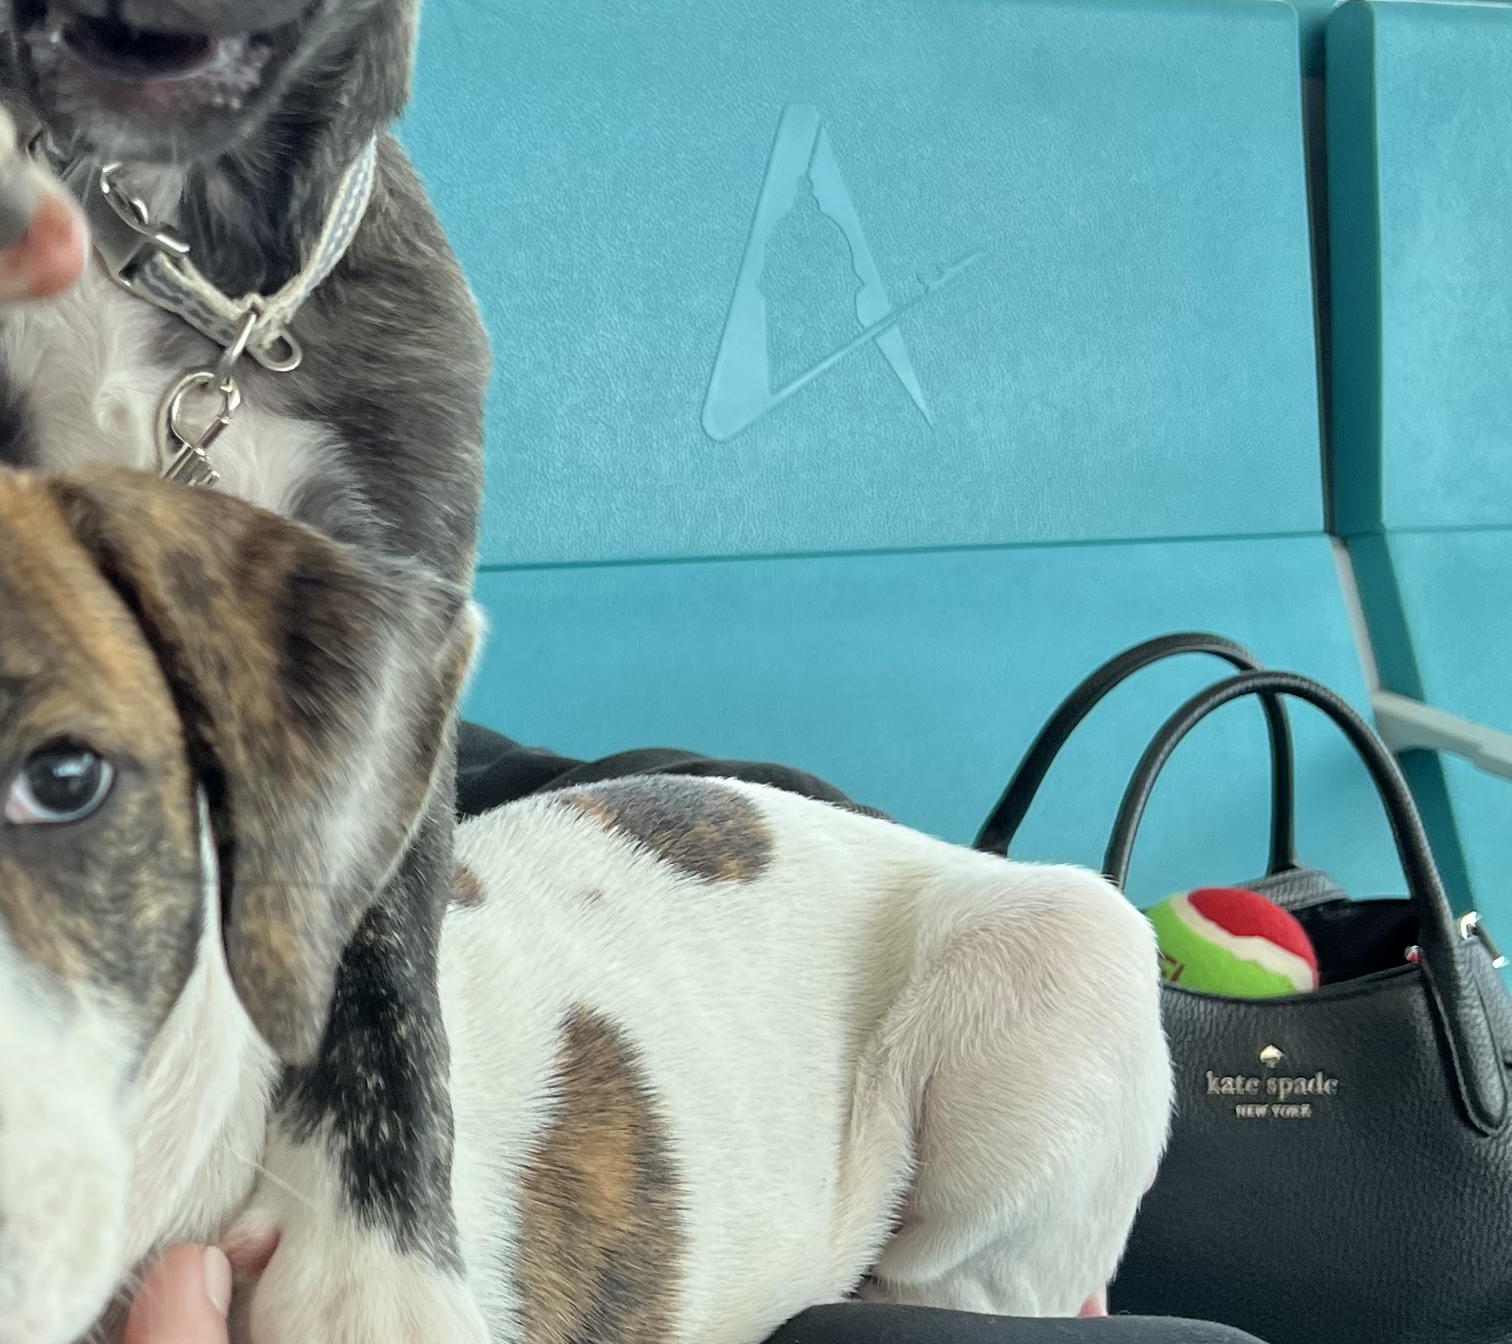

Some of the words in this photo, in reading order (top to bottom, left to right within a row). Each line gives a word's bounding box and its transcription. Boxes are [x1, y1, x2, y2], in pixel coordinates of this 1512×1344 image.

[1205, 1070, 1261, 1095] kate
[1266, 1070, 1339, 1102] spade
[1235, 1103, 1268, 1118] NEW
[1271, 1103, 1312, 1118] YORK
